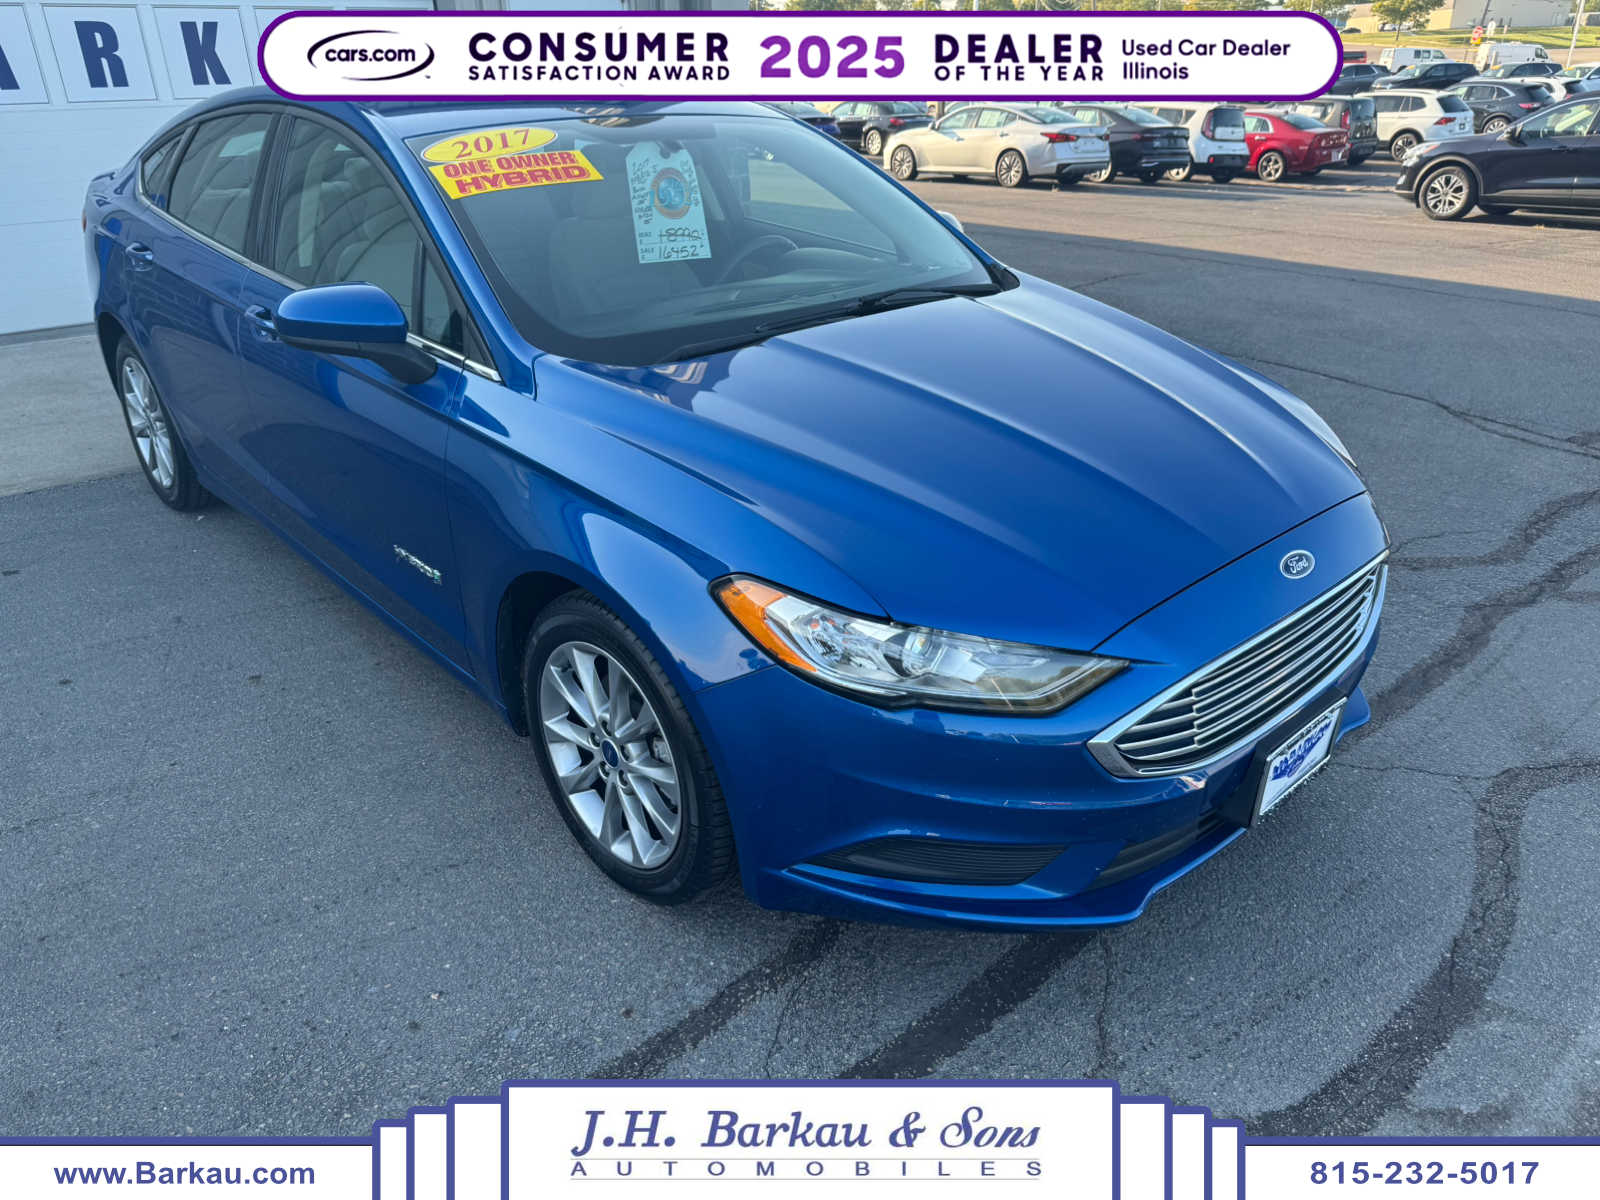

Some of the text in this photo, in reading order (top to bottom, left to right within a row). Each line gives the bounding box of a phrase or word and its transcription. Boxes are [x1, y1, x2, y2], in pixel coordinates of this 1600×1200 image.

[450, 128, 530, 159] 2017
[443, 151, 579, 179] ONE OWNER
[455, 165, 591, 194] HYBRID
[1287, 556, 1309, 574] Ford
